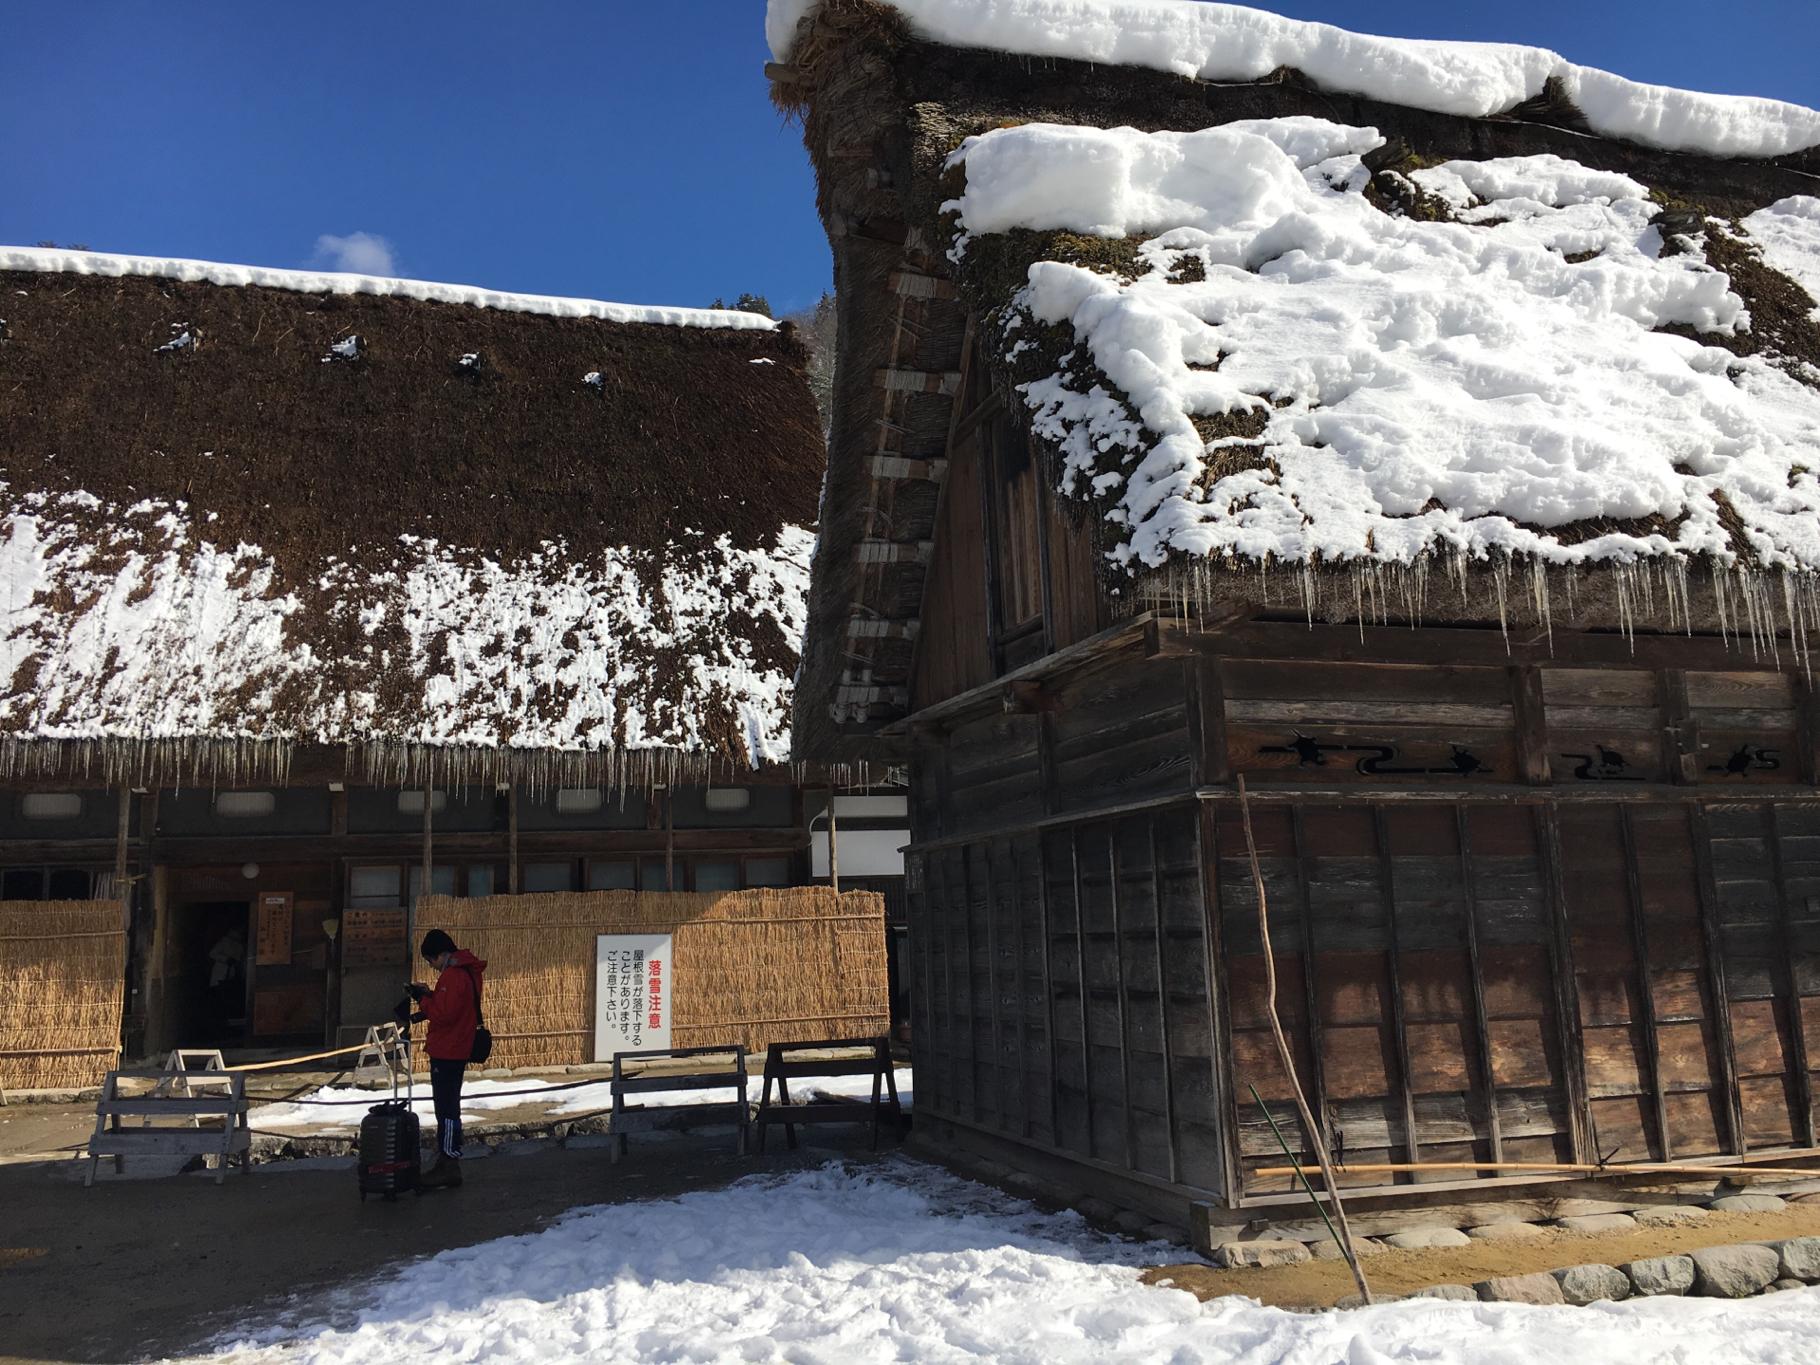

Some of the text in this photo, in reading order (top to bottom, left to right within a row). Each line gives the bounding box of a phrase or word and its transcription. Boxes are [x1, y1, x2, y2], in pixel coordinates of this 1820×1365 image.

[606, 950, 618, 1029] ご注意下さい。
[620, 950, 631, 1041] ことがあります。
[632, 949, 644, 1046] 屋根雪が落下する
[648, 960, 662, 1029] 落雪注意
